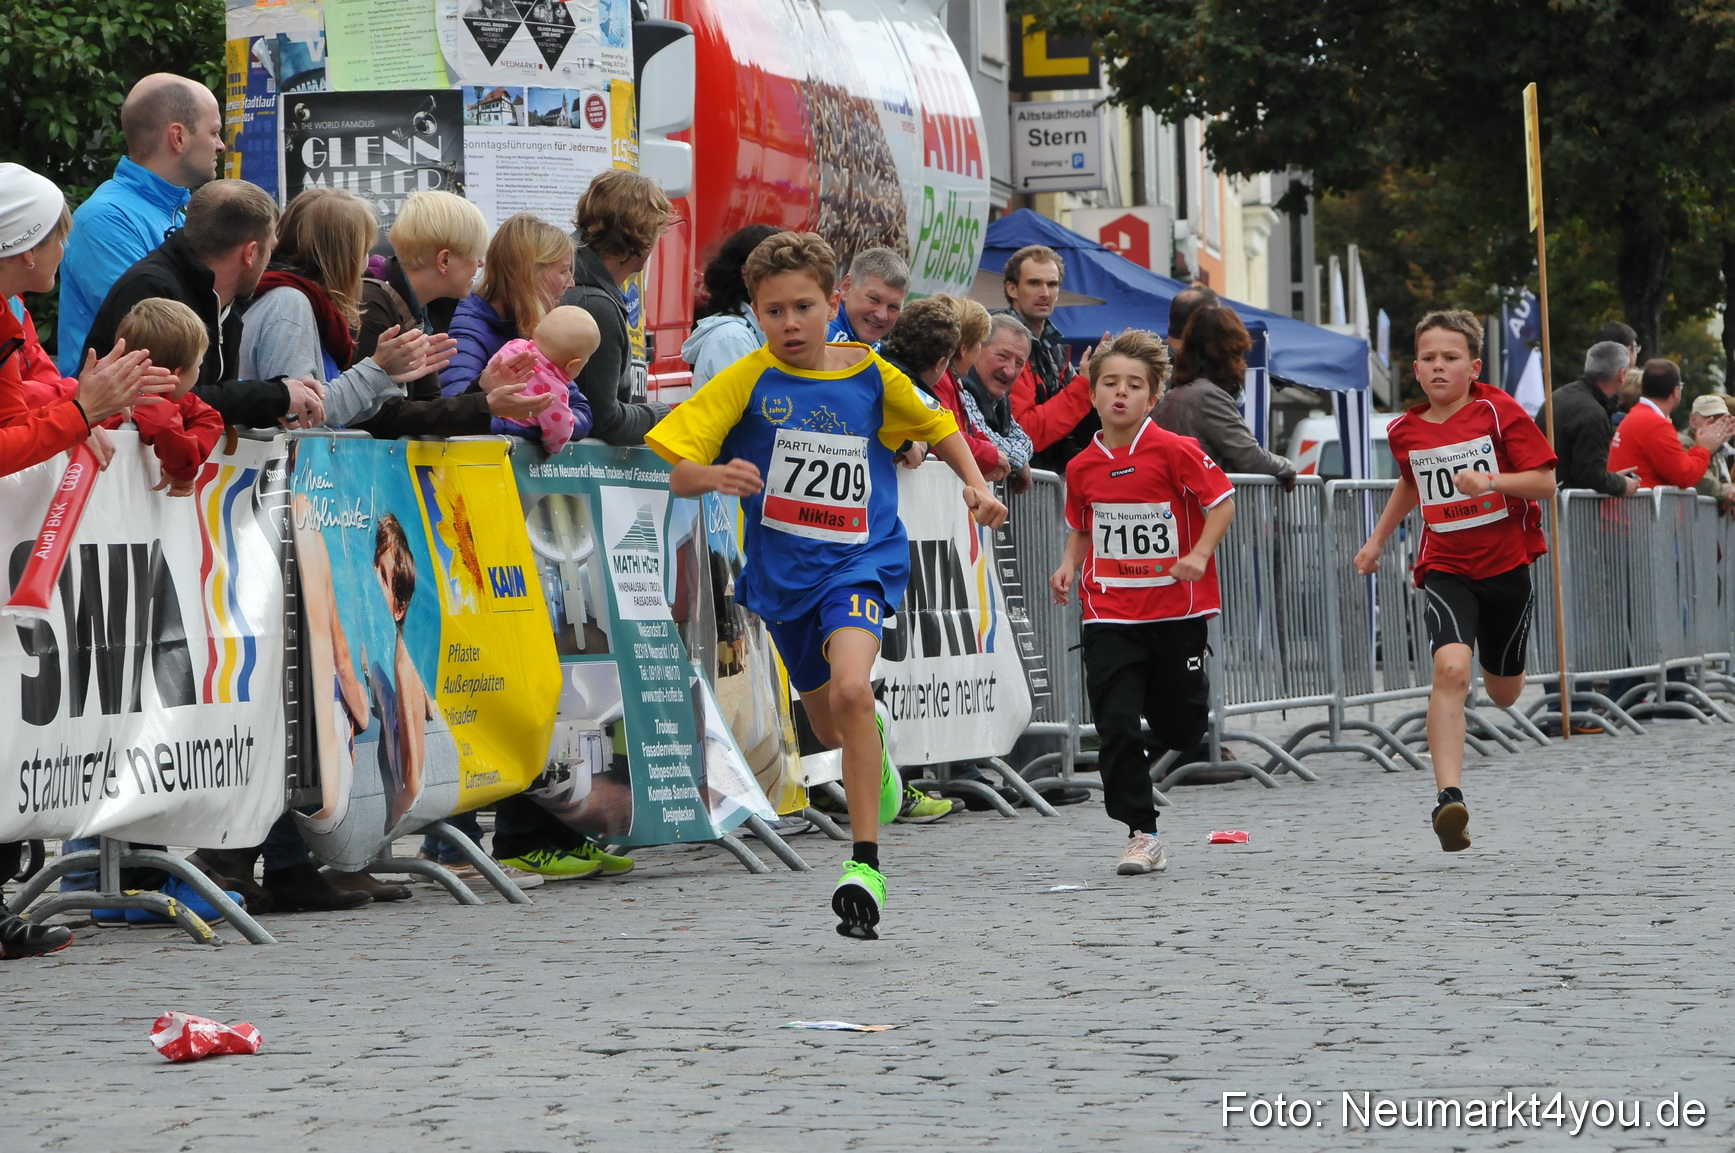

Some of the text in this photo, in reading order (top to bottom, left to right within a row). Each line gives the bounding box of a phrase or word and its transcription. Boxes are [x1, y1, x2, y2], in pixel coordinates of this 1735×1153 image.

[500, 60, 537, 69] NEUMARKT
[240, 94, 276, 108] Stadtlauf
[909, 62, 983, 180] AVIA
[1018, 108, 1096, 122] Altstadthotel
[301, 120, 375, 130] THE WORLD FAMOUS
[463, 139, 607, 153] Sonntagsführungen für Jedermann
[1028, 128, 1086, 147] Stern
[301, 135, 442, 169] GLENN
[302, 169, 442, 195] MILLER
[13, 223, 42, 246] odlo
[908, 185, 979, 285] Pellets
[777, 439, 861, 458] PARTL Neumarkt
[1412, 448, 1479, 467] PARTL Neumarkt
[266, 468, 287, 482] Strom
[301, 458, 334, 492] Mein
[529, 464, 540, 478] Seit
[540, 464, 552, 478] 1965
[553, 464, 559, 478] in
[559, 464, 588, 478] Neumarkt!
[783, 456, 866, 502] 7209
[798, 507, 845, 527] Niklas
[1094, 510, 1160, 520] PARTL Neumarkt
[1443, 504, 1478, 519] Kilian
[35, 502, 68, 560] Audi BKK
[1099, 523, 1170, 554] 7163
[613, 555, 641, 574] MATHI
[1118, 564, 1149, 575] Linus
[849, 594, 879, 624] 10
[448, 643, 480, 662] Pflaster
[443, 675, 505, 698] Außenplatten
[126, 725, 254, 795] neumarkt
